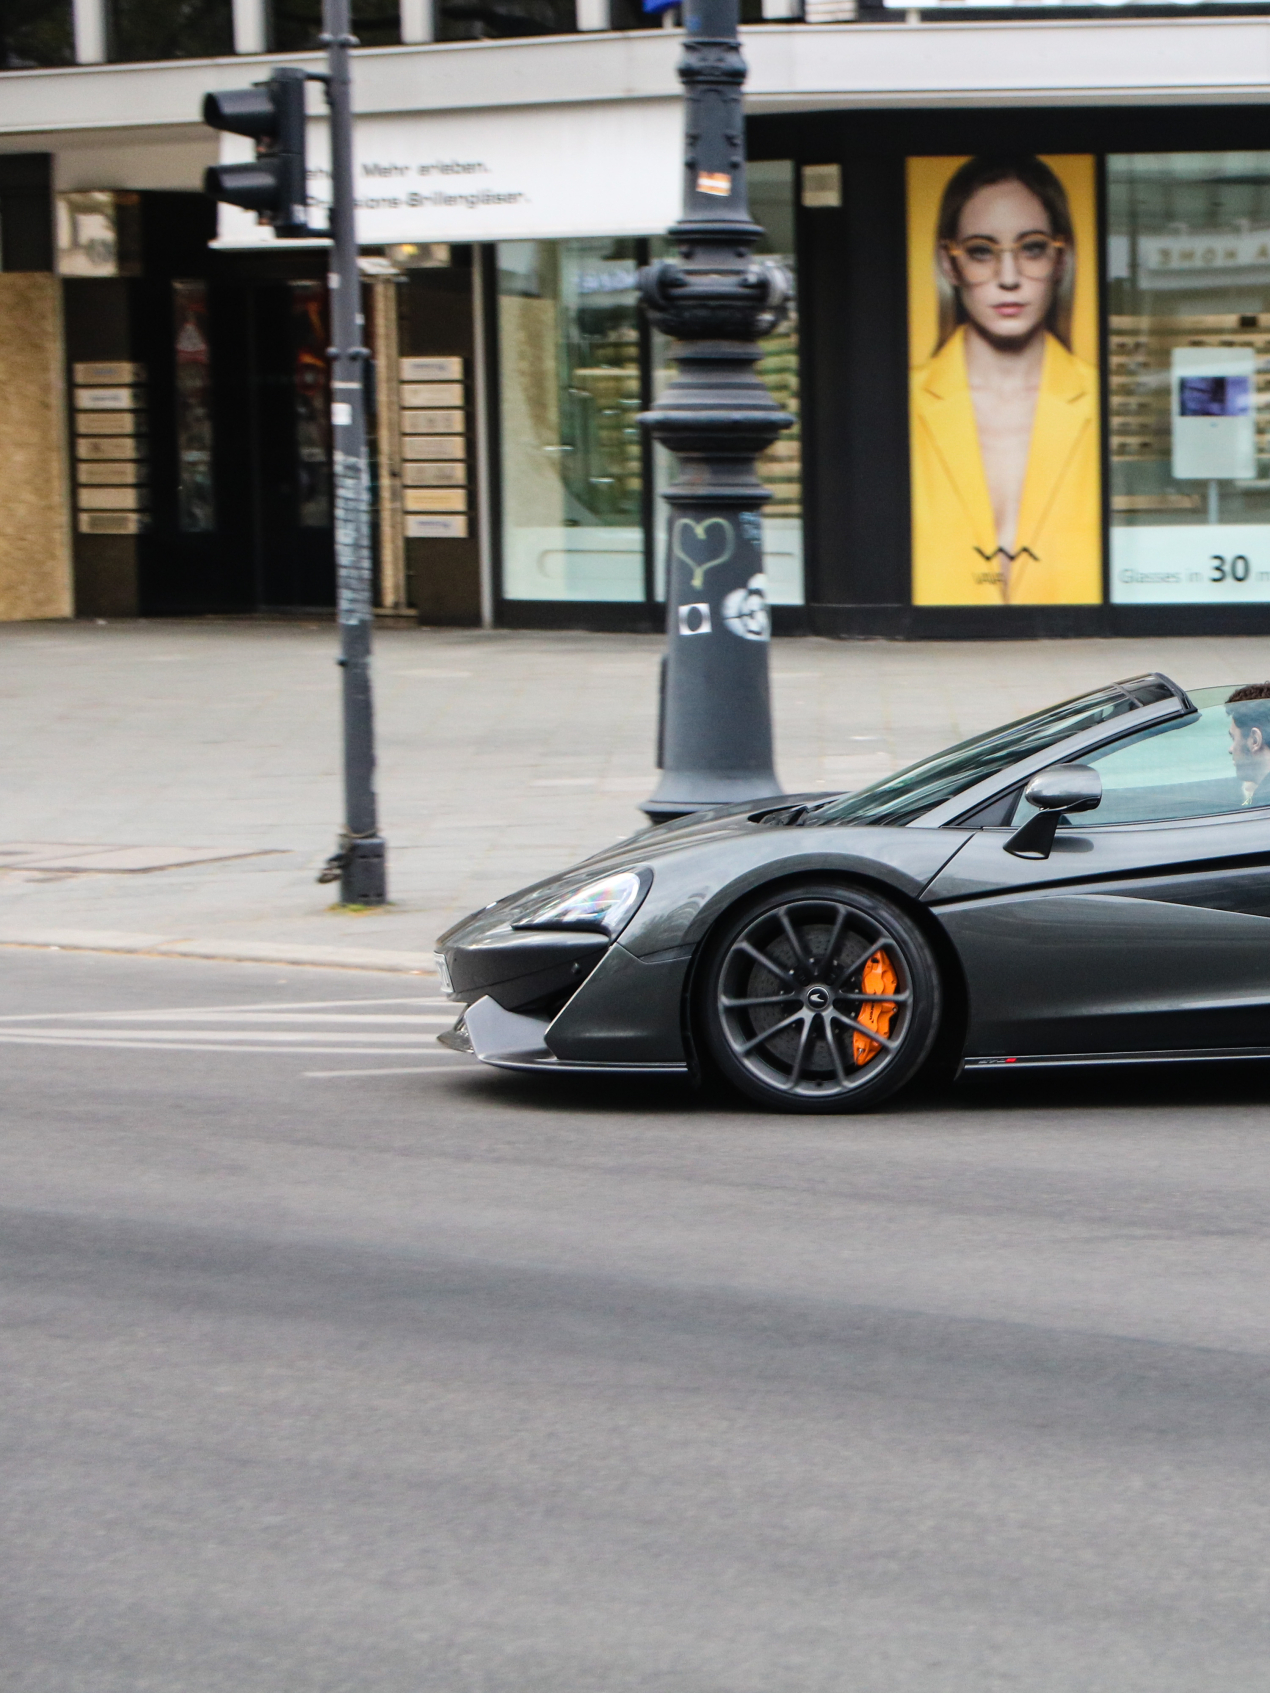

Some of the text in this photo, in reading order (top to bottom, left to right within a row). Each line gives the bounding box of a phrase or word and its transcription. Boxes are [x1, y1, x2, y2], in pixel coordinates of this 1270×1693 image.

[362, 158, 491, 178] Mehr erleben.
[1119, 569, 1182, 584] Glasses
[1187, 568, 1204, 583] in
[1210, 554, 1250, 583] 30
